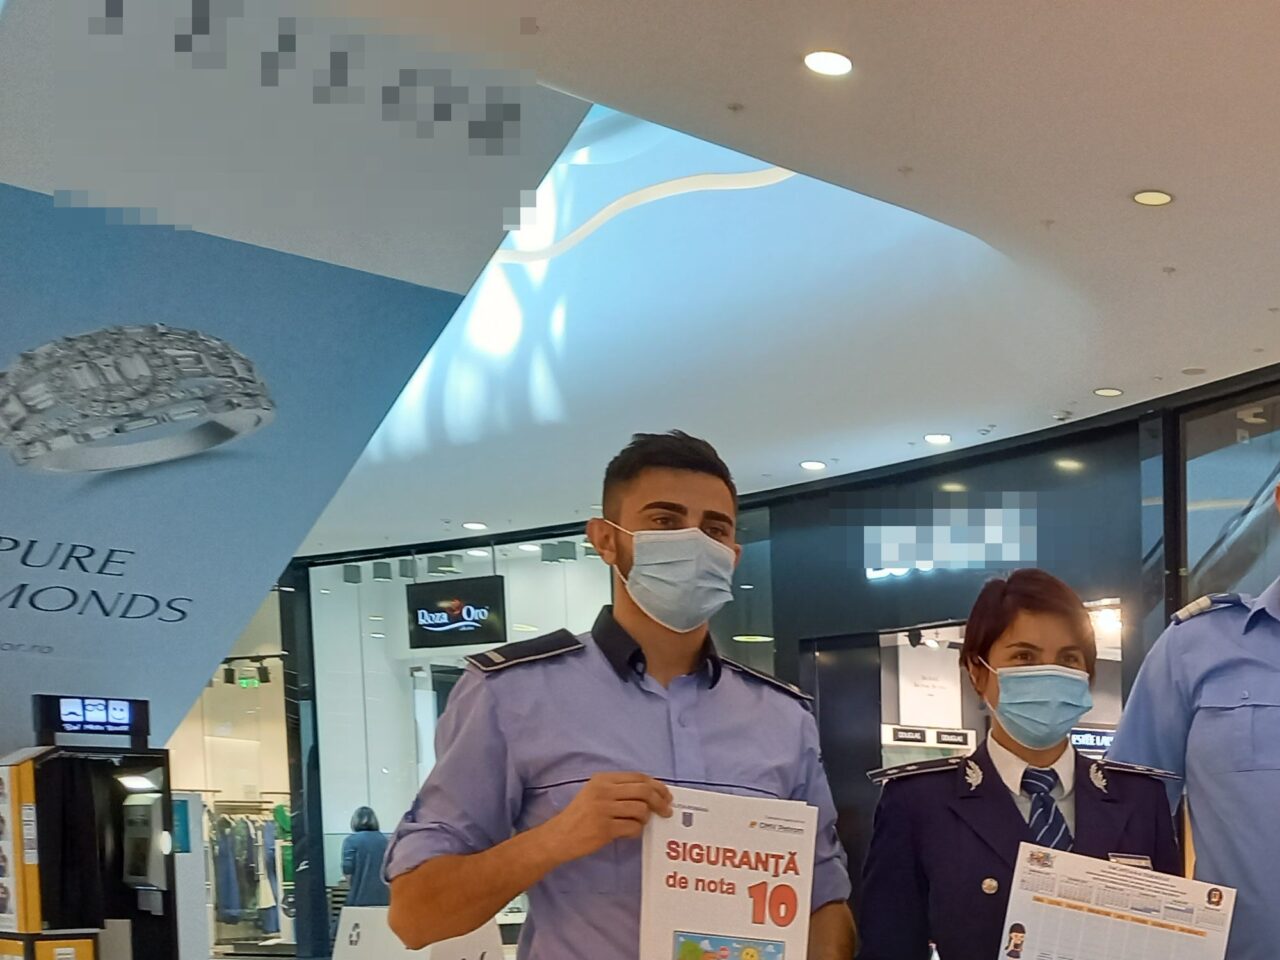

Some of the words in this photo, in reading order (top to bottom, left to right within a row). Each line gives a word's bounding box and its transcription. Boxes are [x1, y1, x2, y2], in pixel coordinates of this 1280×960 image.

[417, 609, 450, 625] Roza
[462, 605, 489, 621] Oro
[665, 840, 800, 878] SIGURANȚĂ
[665, 871, 688, 890] de
[694, 878, 736, 896] nota
[747, 881, 798, 928] 10
